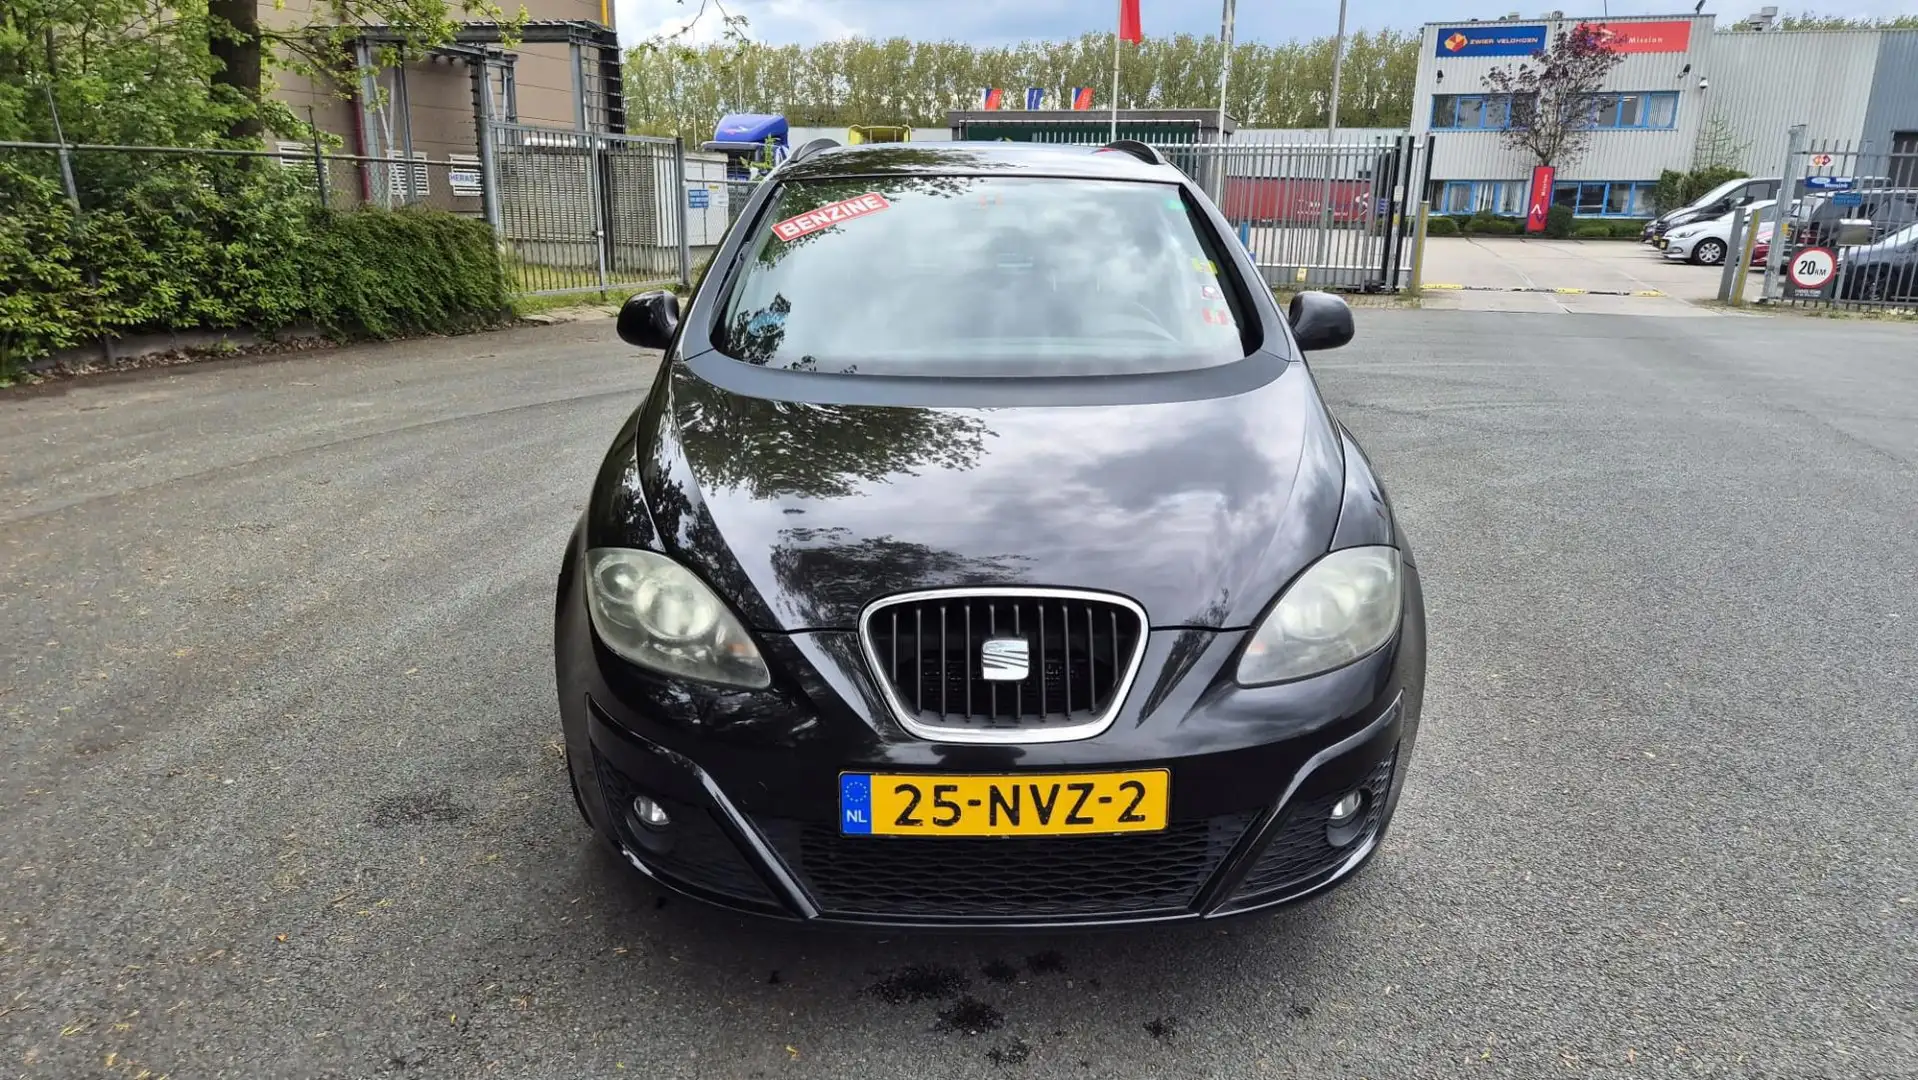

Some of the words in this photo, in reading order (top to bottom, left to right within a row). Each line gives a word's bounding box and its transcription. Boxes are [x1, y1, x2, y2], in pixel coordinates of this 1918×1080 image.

[1629, 36, 1663, 44] Mission
[779, 196, 883, 237] BENZINE
[1798, 260, 1817, 276] 20
[894, 780, 1147, 827] 25-NVZ-2
[846, 810, 867, 823] NL
